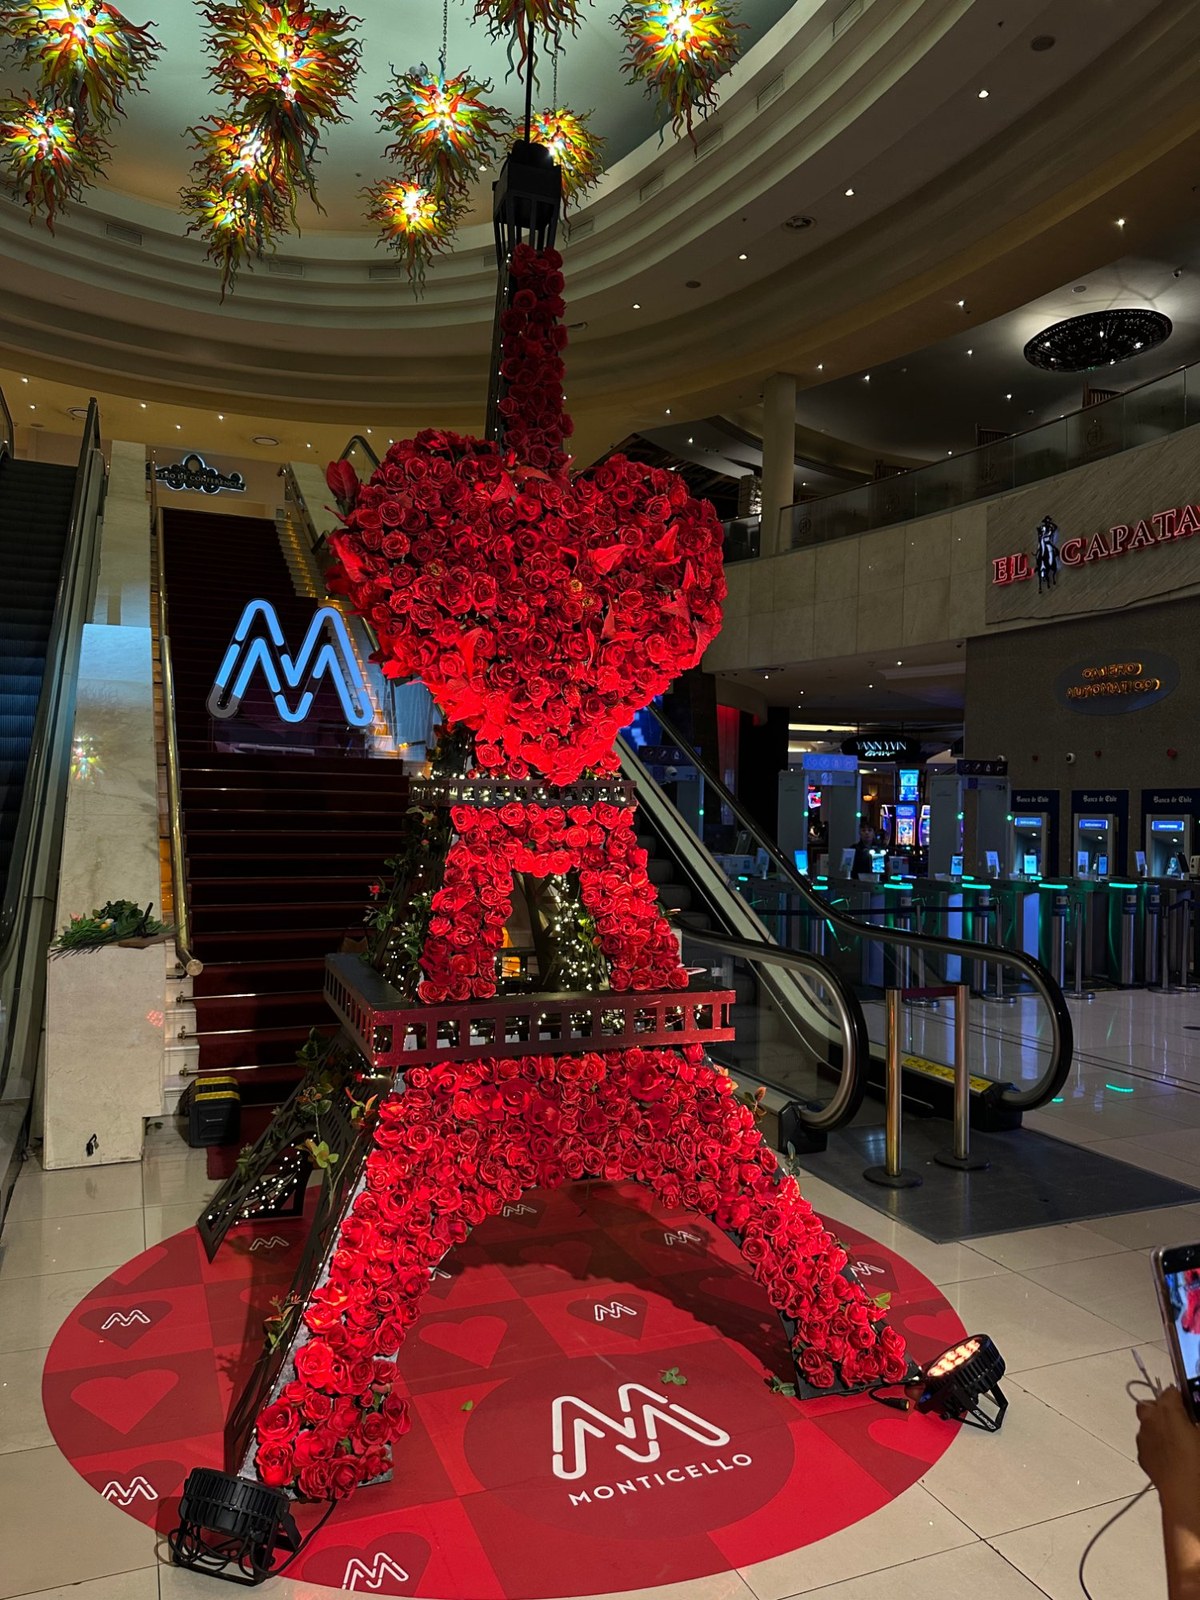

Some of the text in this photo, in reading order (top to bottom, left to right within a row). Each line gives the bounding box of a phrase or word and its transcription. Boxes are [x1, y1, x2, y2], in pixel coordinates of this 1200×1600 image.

[992, 505, 1200, 585] EL CAPATA
[856, 741, 882, 750] YANN
[568, 1453, 752, 1506] MONTICELLO
